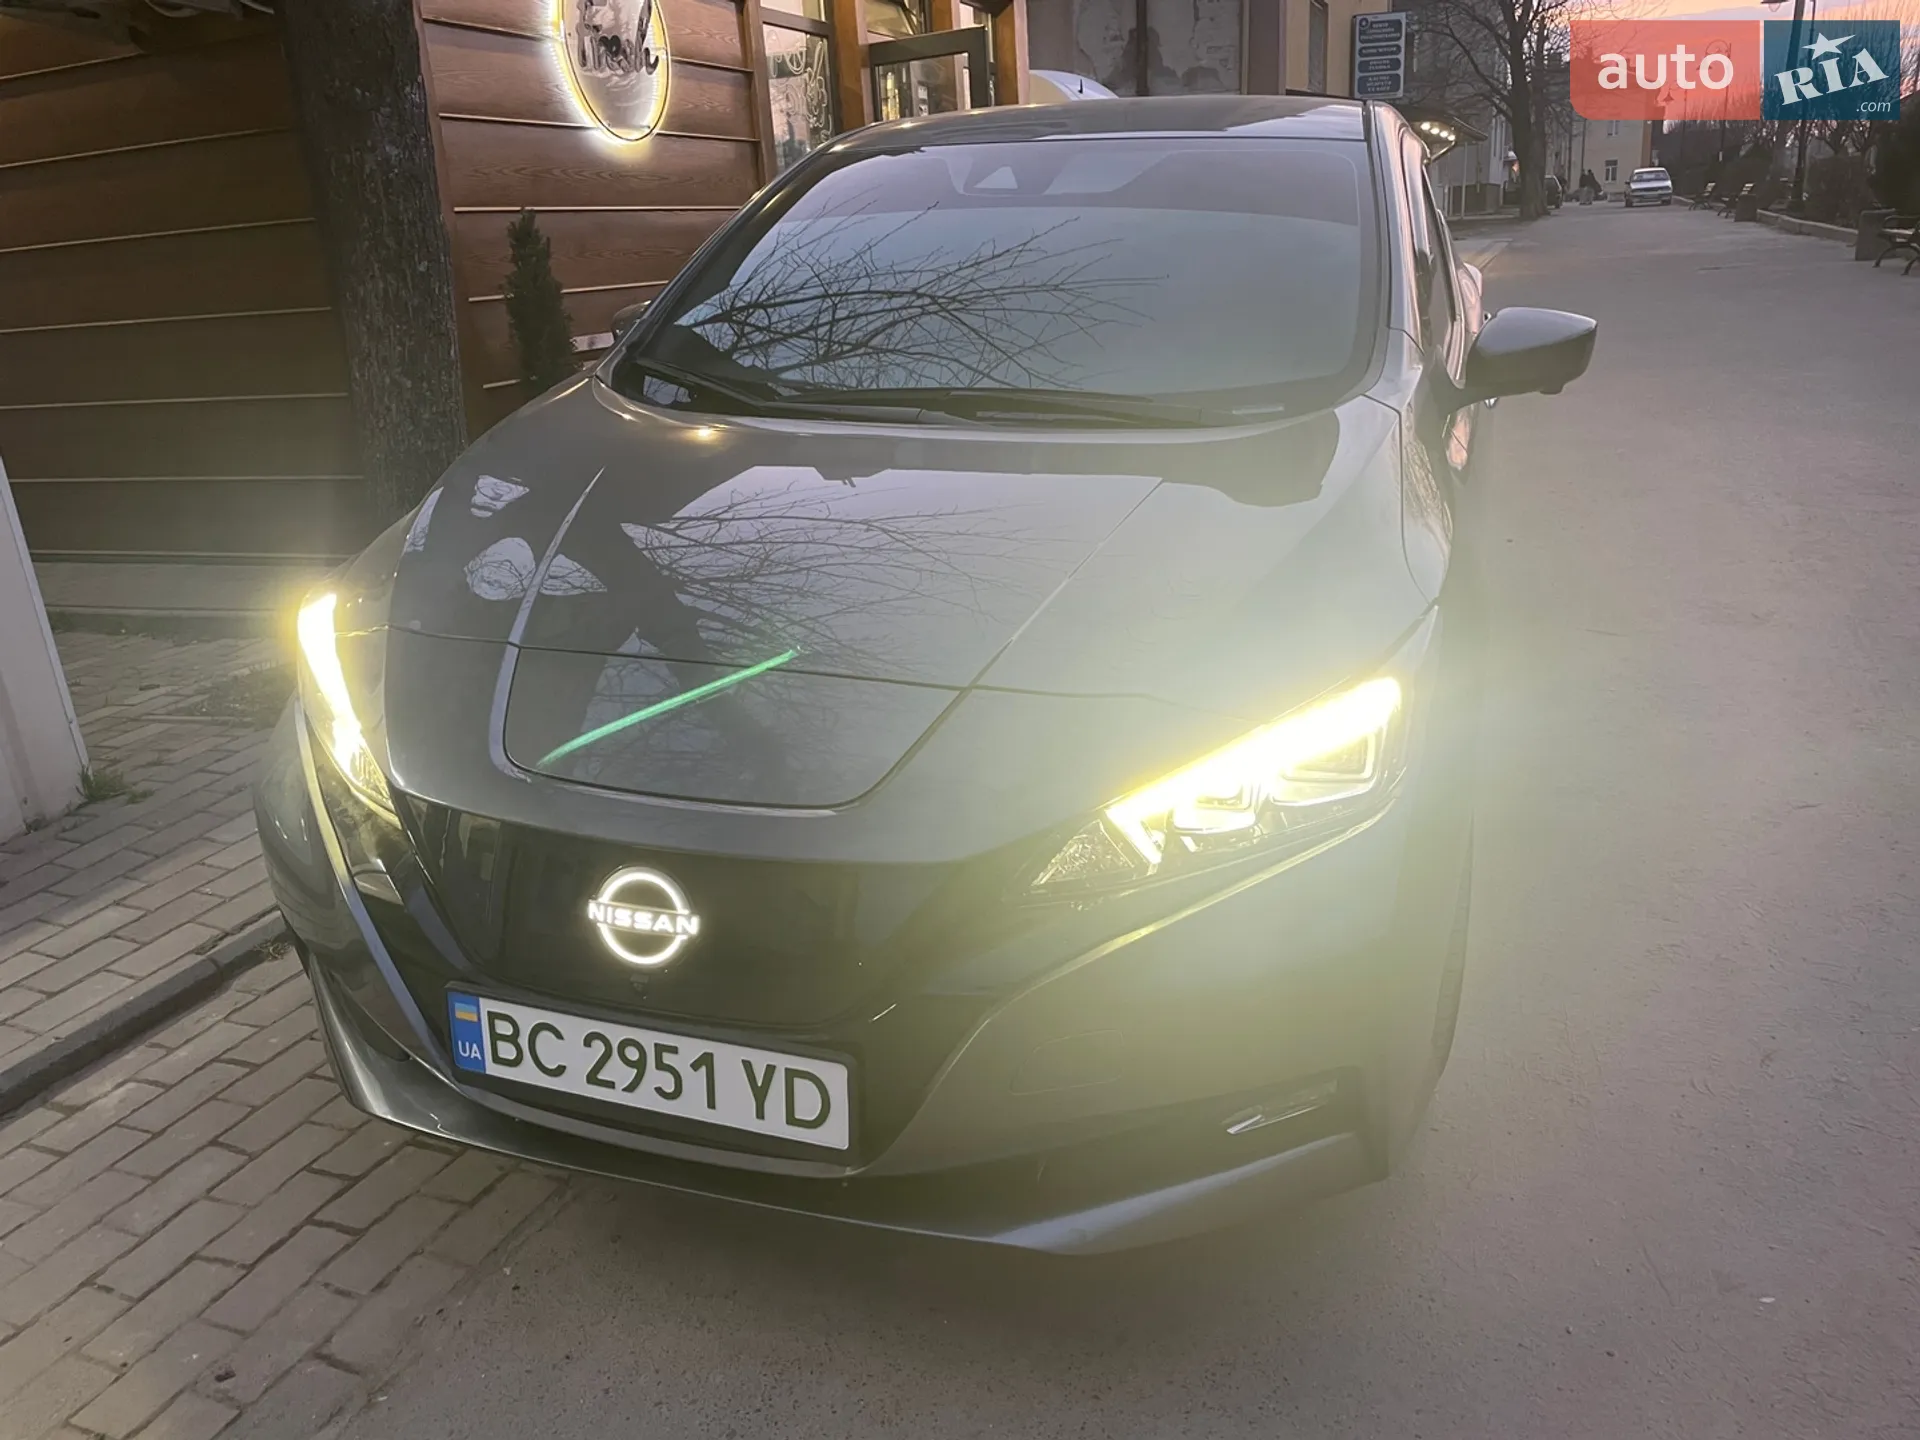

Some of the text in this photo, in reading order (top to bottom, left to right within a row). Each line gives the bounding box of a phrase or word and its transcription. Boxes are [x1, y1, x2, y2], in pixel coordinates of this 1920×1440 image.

[588, 901, 700, 935] NISSAN
[457, 1039, 482, 1061] UA
[486, 1011, 831, 1130] BC 2951 YD
